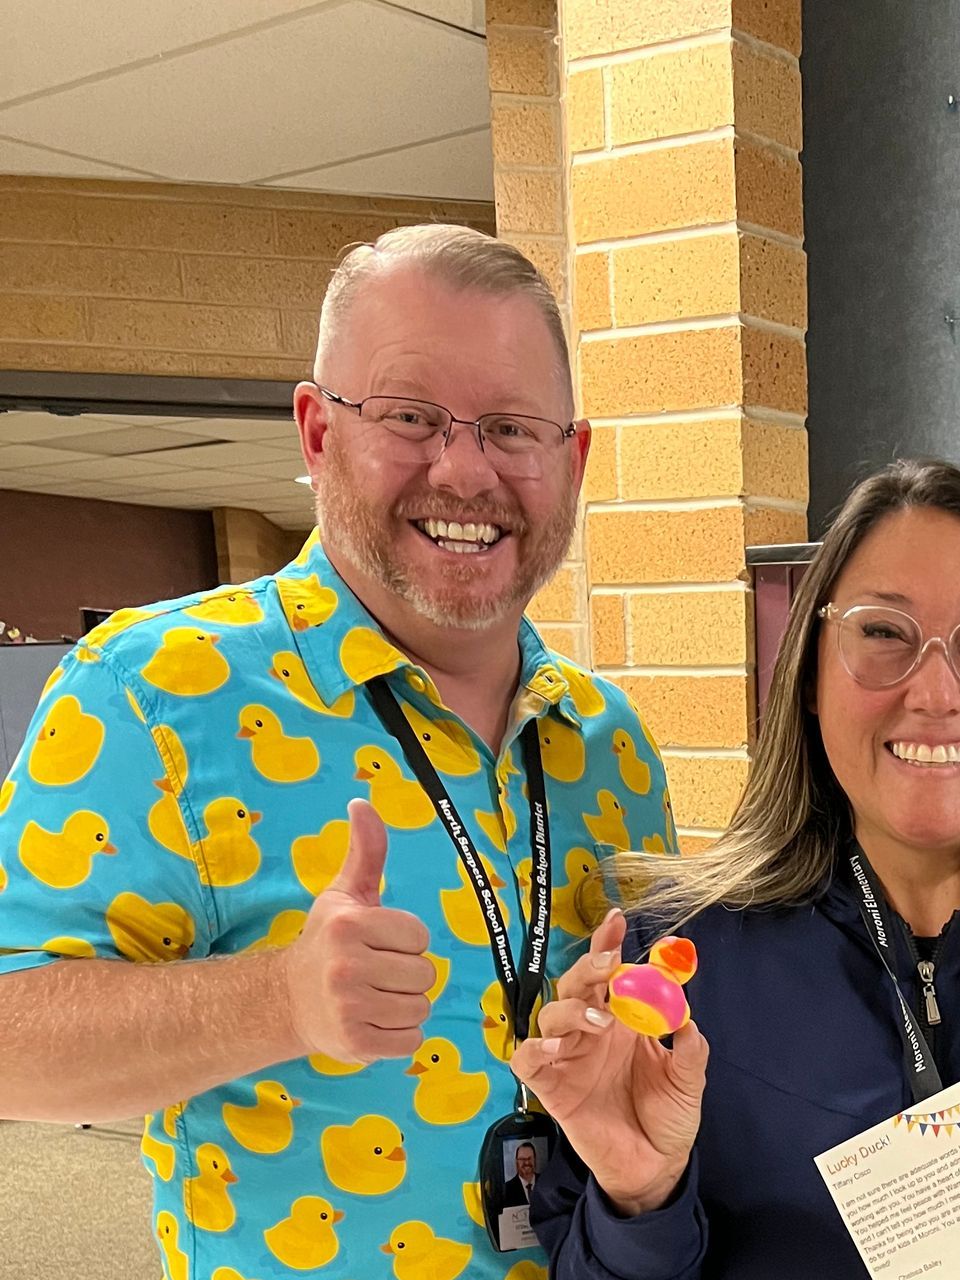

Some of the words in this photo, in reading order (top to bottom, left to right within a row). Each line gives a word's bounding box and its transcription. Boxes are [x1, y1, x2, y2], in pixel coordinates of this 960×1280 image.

[534, 801, 545, 845] District
[536, 845, 548, 887] School
[849, 855, 878, 908] Elementary
[438, 799, 462, 839] North
[458, 836, 485, 888] Sanpete
[481, 889, 503, 934] School
[495, 934, 514, 984] District
[867, 909, 889, 948] Moroni
[528, 935, 546, 974] North
[908, 1030, 926, 1073] Moroni
[827, 1154, 857, 1175] Lucky
[859, 1135, 891, 1158] Duck!
[924, 1171, 935, 1181] you
[902, 1193, 915, 1202] You
[855, 1227, 868, 1236] You
[941, 1219, 955, 1228] You
